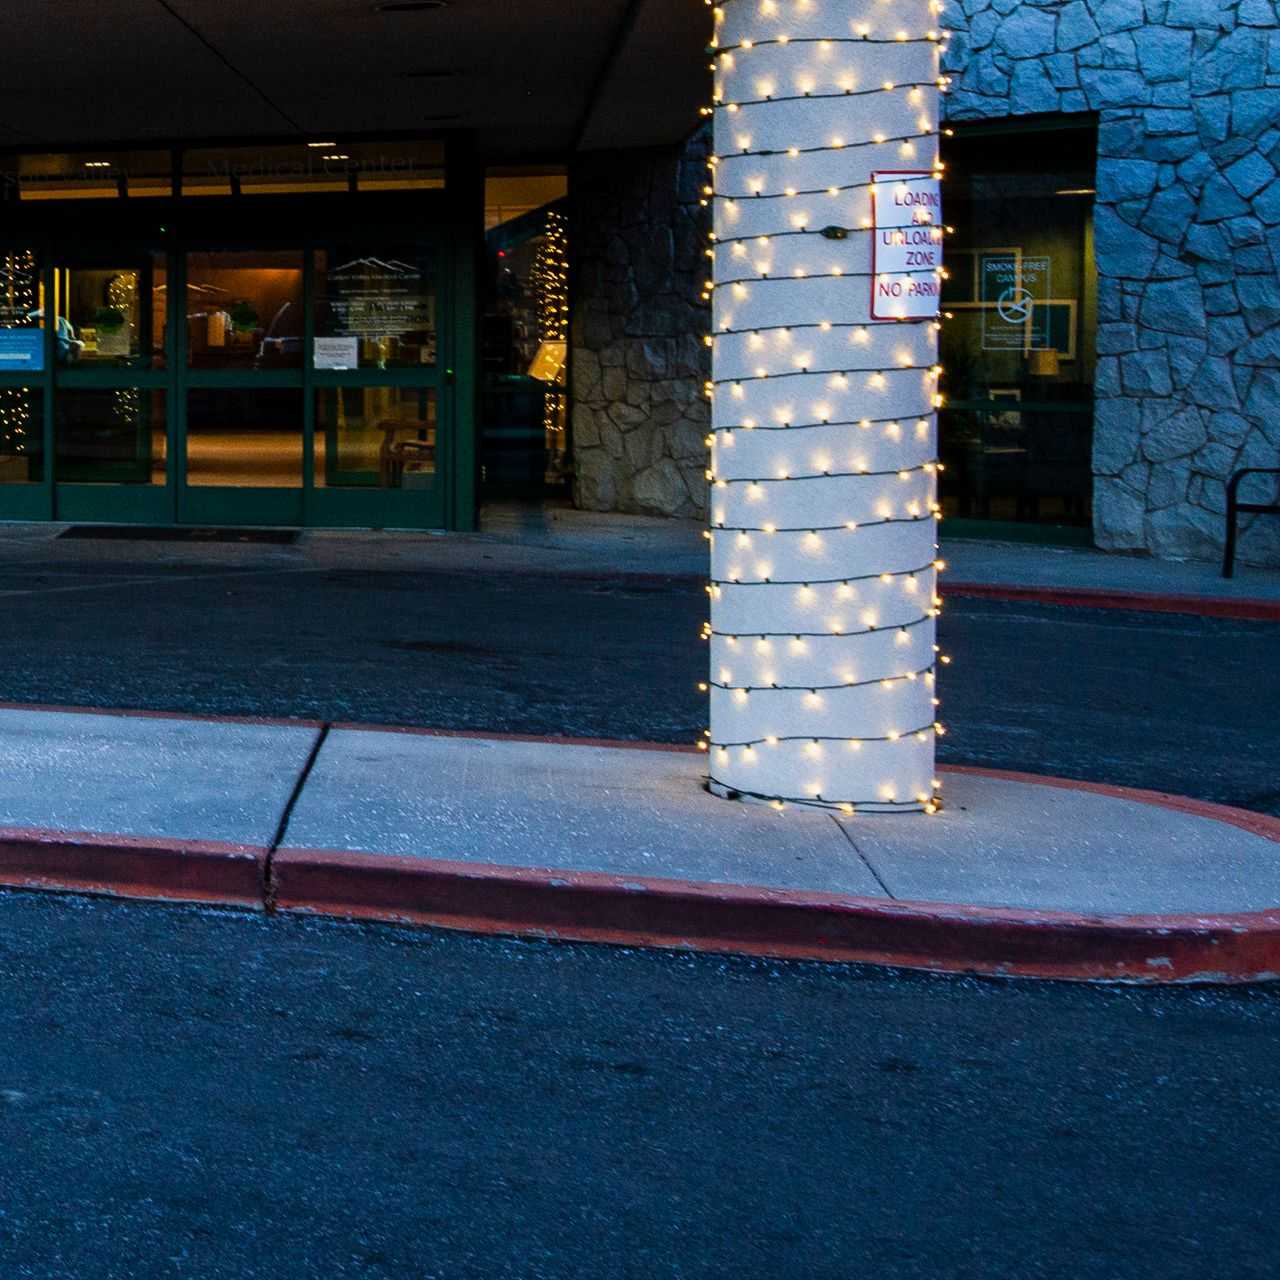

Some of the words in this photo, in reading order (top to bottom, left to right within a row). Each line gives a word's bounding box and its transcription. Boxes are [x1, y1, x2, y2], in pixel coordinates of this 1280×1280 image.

[912, 211, 934, 226] AD
[905, 251, 935, 266] ZONE
[879, 282, 902, 297] NO
